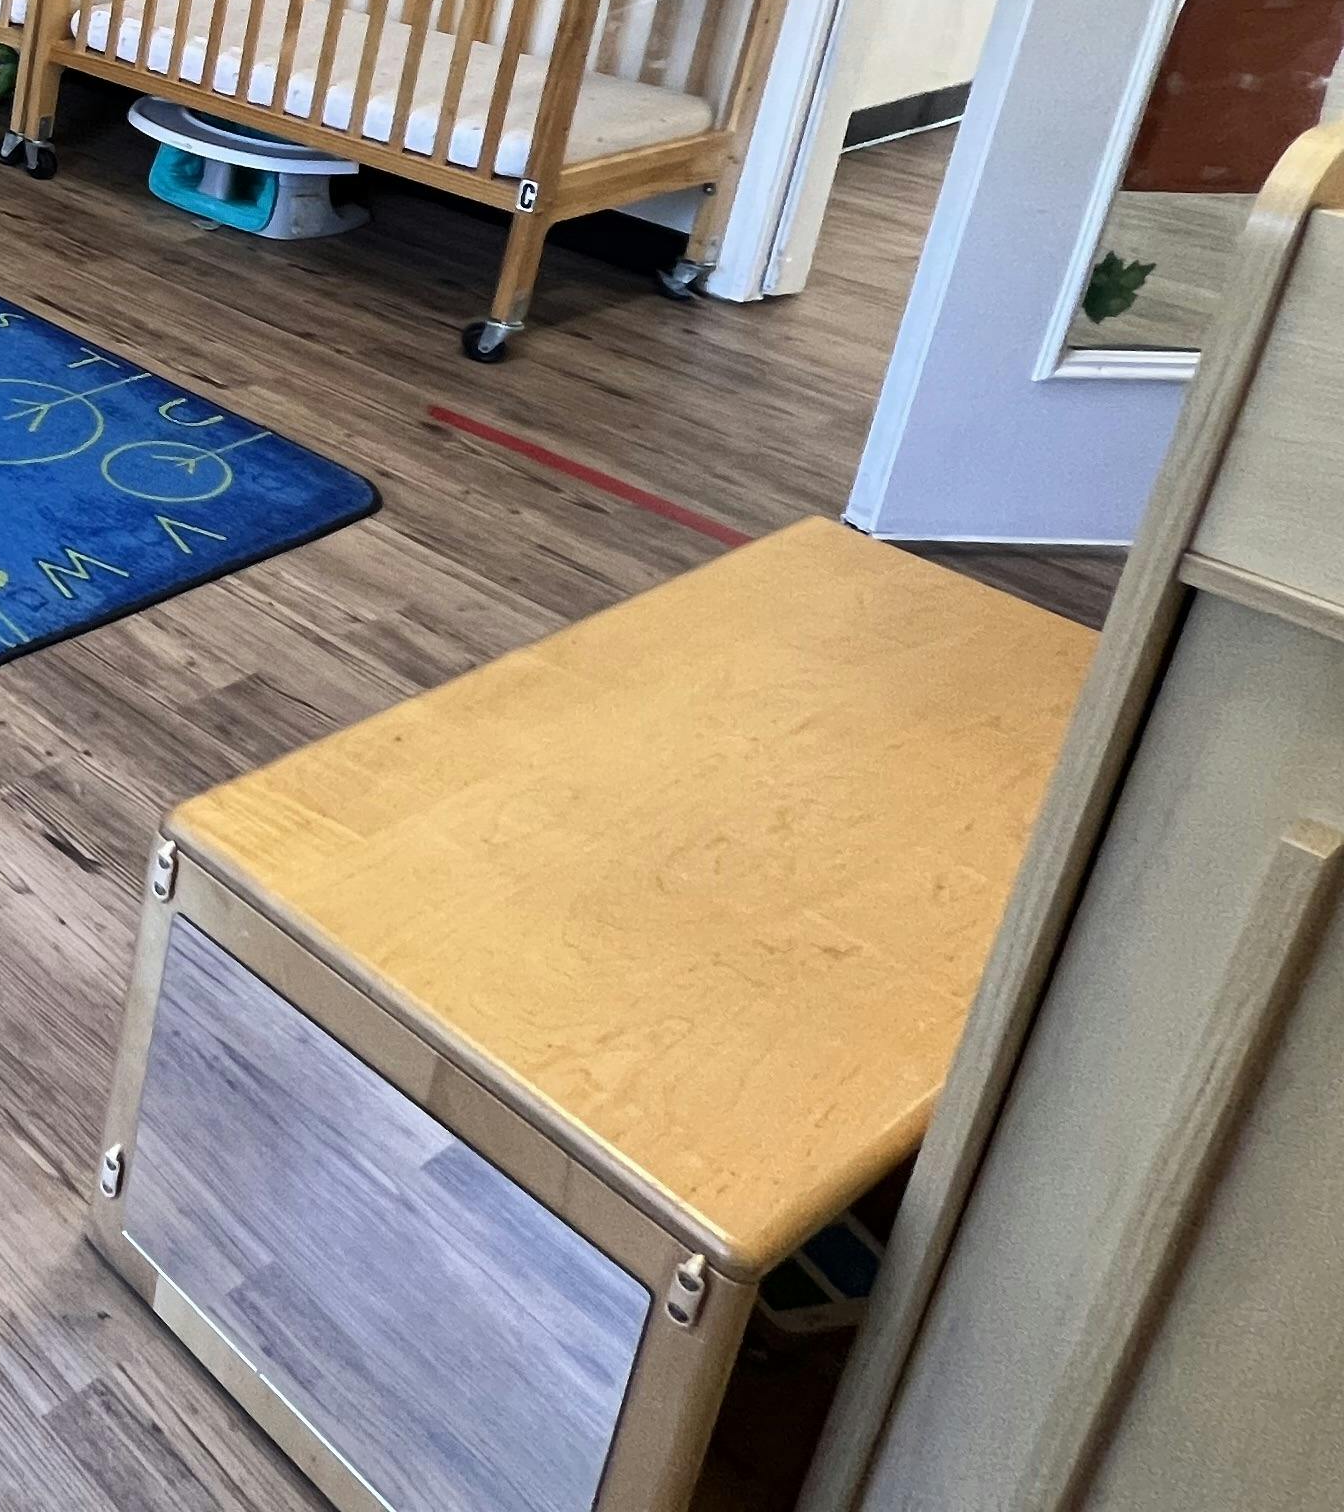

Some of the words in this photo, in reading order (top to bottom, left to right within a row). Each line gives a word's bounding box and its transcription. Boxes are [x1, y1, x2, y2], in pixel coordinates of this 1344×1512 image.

[520, 183, 536, 210] C
[66, 347, 123, 370] T
[160, 398, 224, 427] U
[157, 515, 227, 554] V
[38, 545, 131, 600] W
